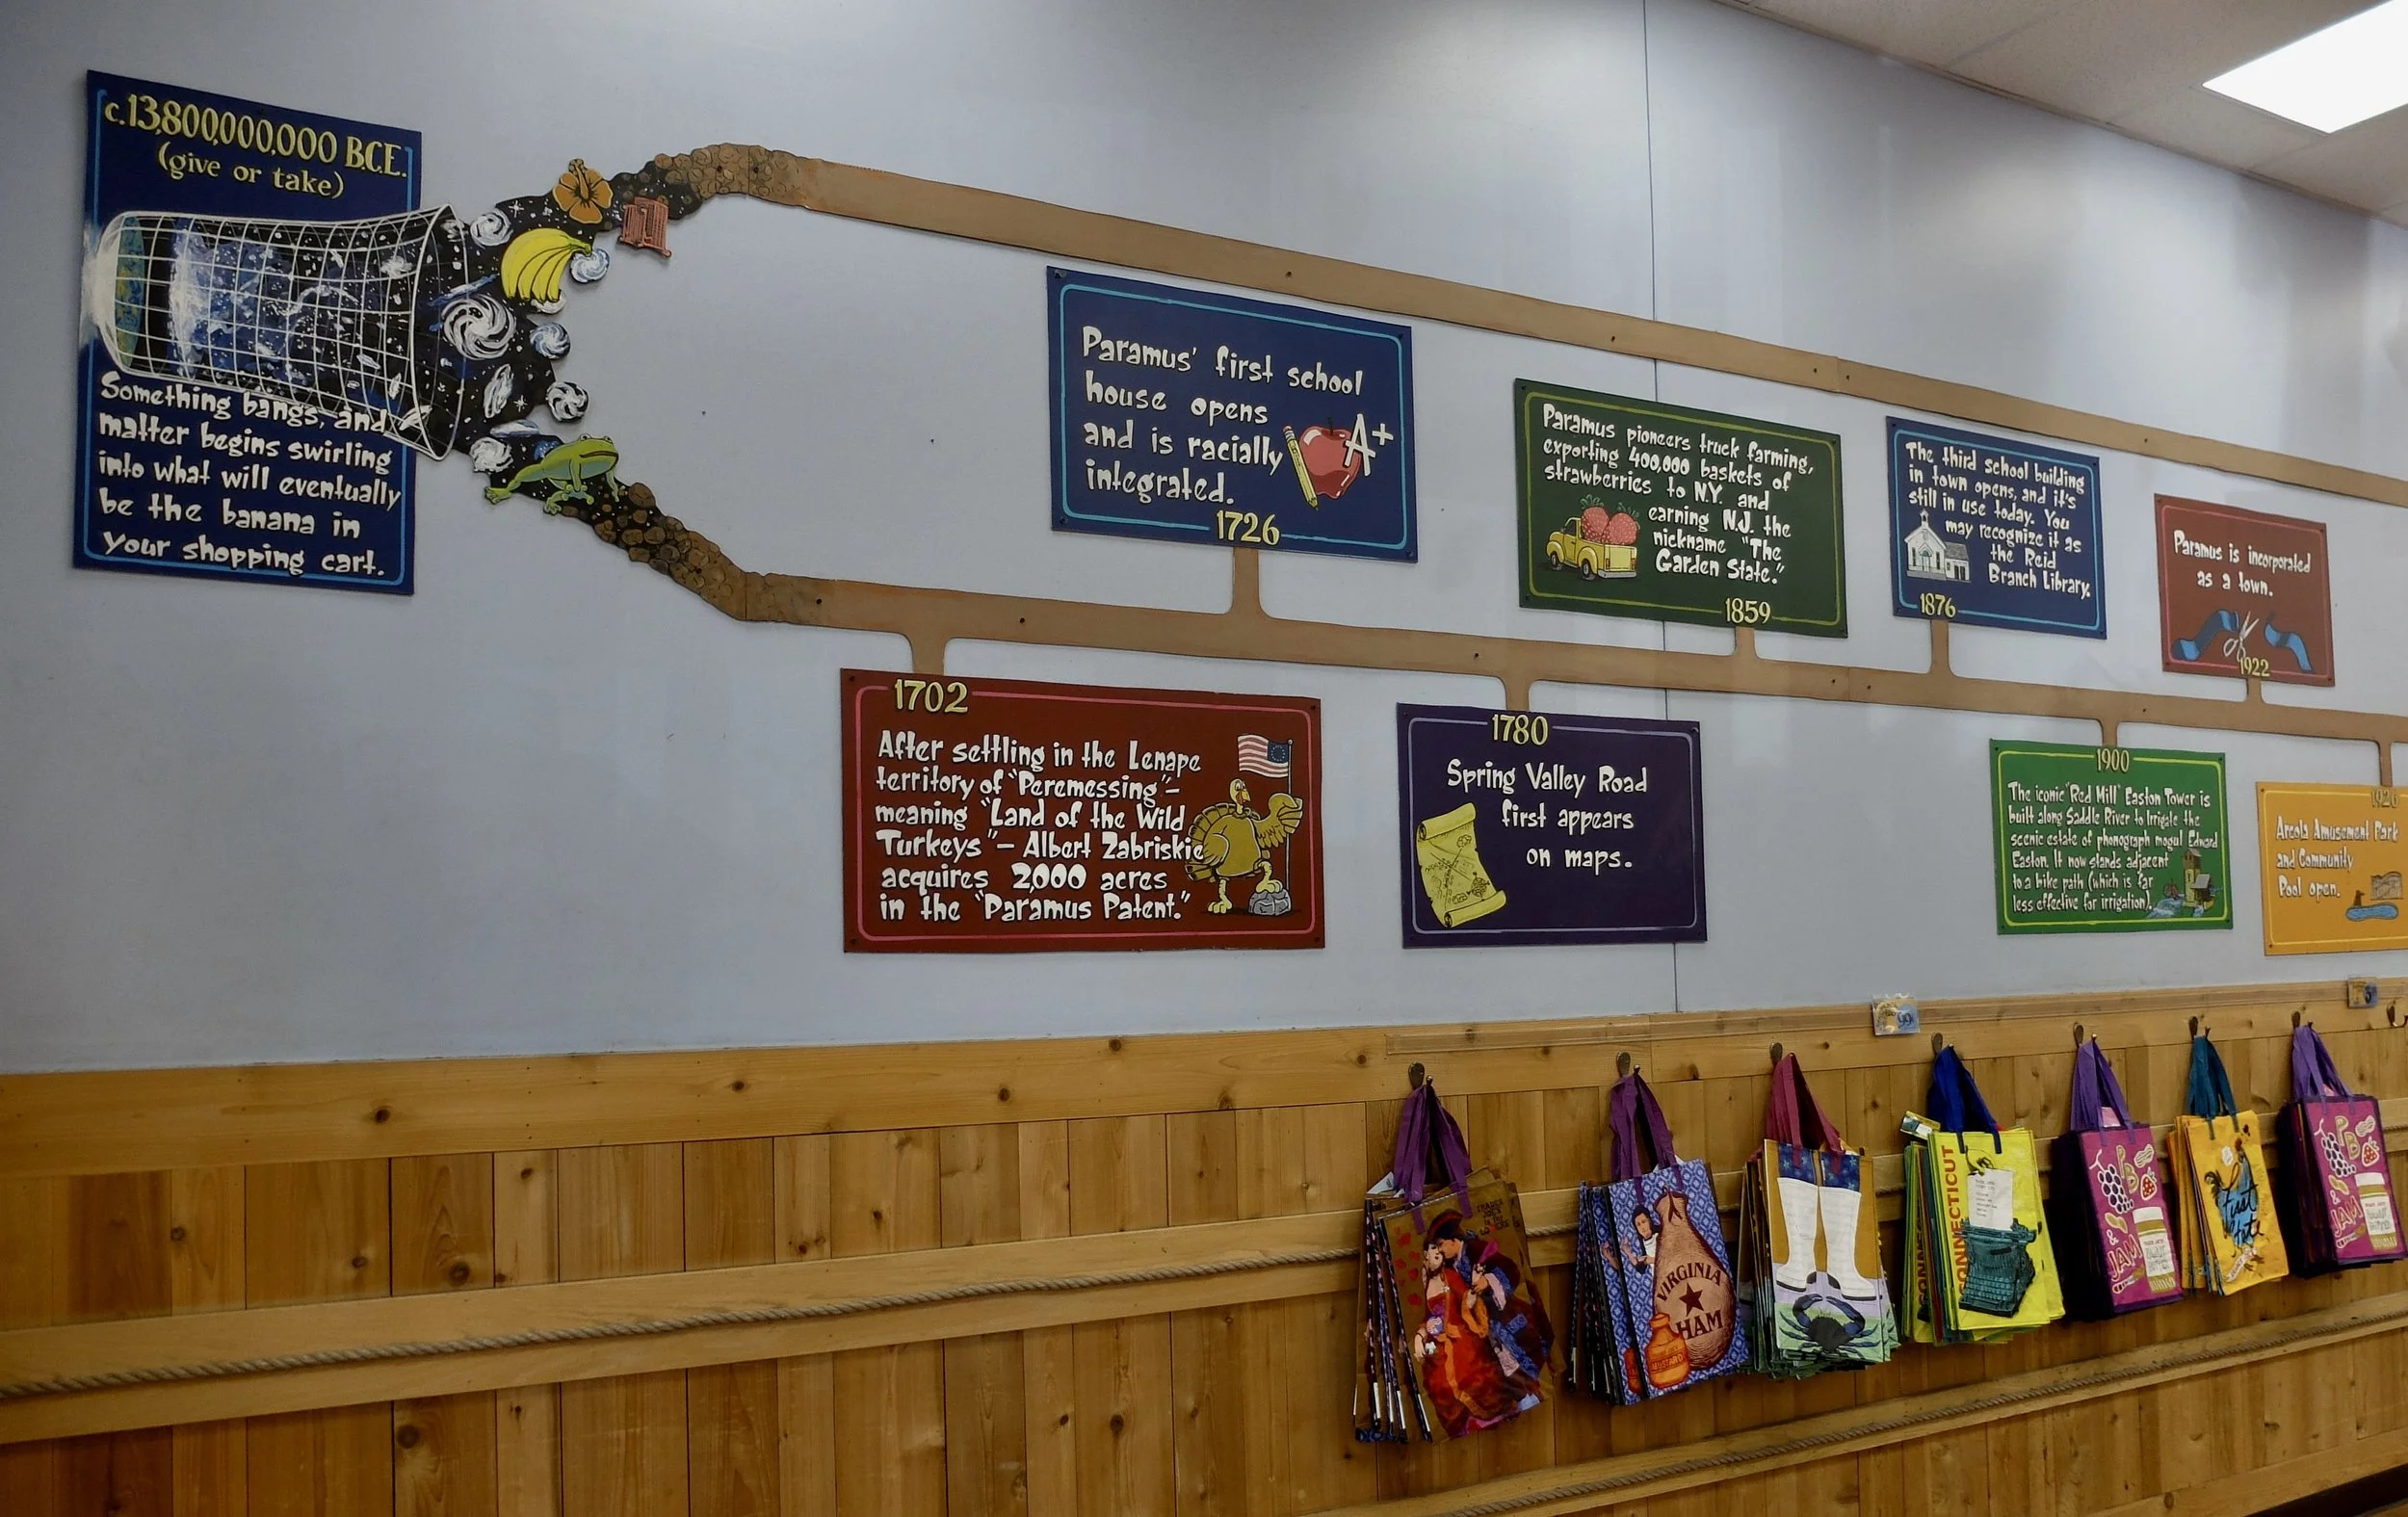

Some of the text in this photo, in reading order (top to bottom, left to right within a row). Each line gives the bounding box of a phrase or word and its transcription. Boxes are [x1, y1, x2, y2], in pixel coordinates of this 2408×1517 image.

[158, 142, 345, 199] (give or take)
[1082, 326, 1364, 396] Paramus' first school
[100, 371, 388, 433] Something bangs, and
[1085, 370, 1269, 427] house opens
[98, 412, 393, 475] matter begins swirling
[1083, 420, 1283, 476] and is racially
[1542, 403, 1814, 475] Paramus pioneers truck farming,
[1542, 438, 1619, 469] exporting
[1700, 459, 1762, 487] baskets
[1905, 441, 2084, 494] The third school building
[98, 450, 402, 511] into what will eventually
[1085, 458, 1235, 505] integrated.
[1544, 459, 1653, 495] strawberries
[1666, 477, 1687, 498] to
[1737, 490, 1769, 511] and
[1908, 464, 1924, 484] in
[1932, 465, 1968, 491] town
[1975, 482, 2018, 501] opens,
[2021, 487, 2046, 505] and
[98, 487, 361, 538] be the banana in
[1648, 507, 1710, 533] earning
[1763, 516, 1792, 538] the
[1908, 489, 2070, 530] still in use today. You
[1216, 510, 1280, 546] 1726
[1653, 529, 1727, 555] nickname
[1945, 520, 2081, 553] may recognize it as
[102, 531, 385, 577] your shopping cart.
[1655, 549, 1719, 577] Garden
[1990, 544, 2056, 569] the Reid
[2173, 530, 2311, 574] Paramus is incorporated
[1988, 562, 2091, 599] Branch Library.
[2197, 570, 2273, 596] as a town.
[1724, 598, 1771, 624] 1859
[1920, 593, 1956, 617] 1876
[2239, 657, 2270, 676] 1922
[894, 678, 969, 714] 1702
[1492, 714, 1549, 745] 1780
[877, 730, 1201, 773] After settling in the Lenape
[2096, 748, 2130, 772] 1900
[876, 767, 1003, 800] territory of
[1447, 758, 1648, 798] Spring Valley Road
[2007, 781, 2212, 808] The iconic Easton Tower is
[875, 801, 1186, 831] meaning of the Wild
[1502, 798, 1635, 836] first appears
[2008, 805, 2200, 827] built along Saddle River the
[2276, 815, 2398, 842] Arcola Amusement Park
[1022, 831, 1205, 861] Albert Zabriskie
[2010, 829, 2218, 851] scenic estate of phonograph mogul Edward
[1526, 847, 1633, 876] on maps.
[2012, 850, 2169, 874] Easton. now stands adjacent
[2276, 847, 2354, 871] and Community
[881, 867, 989, 891] acquires
[1100, 869, 1167, 892] acres
[2035, 872, 2154, 893] bike path (which is far
[2278, 875, 2341, 901] Pool open.
[879, 894, 961, 923] in the
[2013, 891, 2153, 913] less effective for irrigation).
[2331, 1195, 2363, 1238] JAM
[2107, 1234, 2143, 1282] JAM
[1657, 1262, 1722, 1302] VIRGINIA
[1676, 1310, 1724, 1340] HAM
